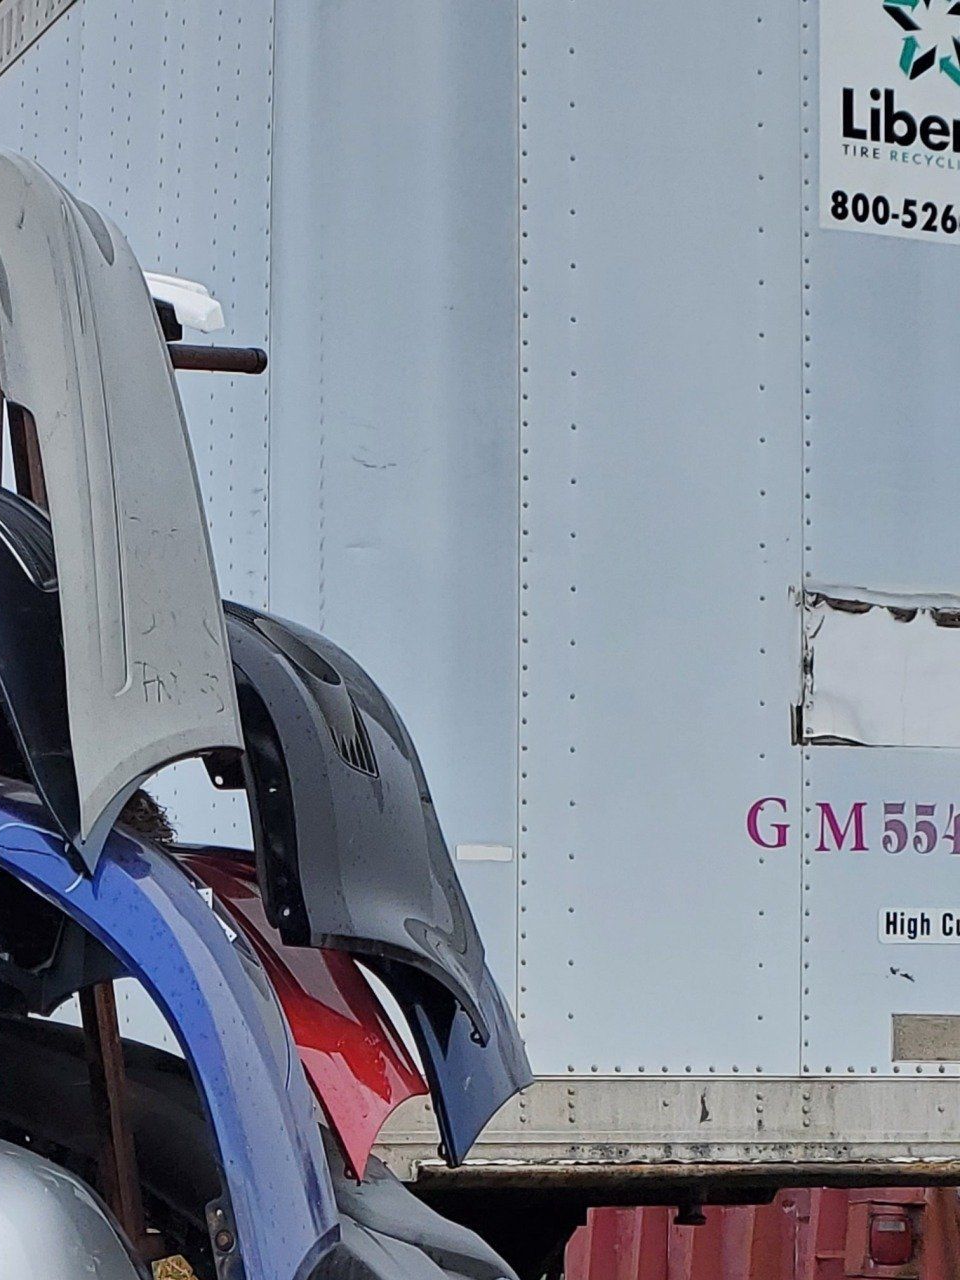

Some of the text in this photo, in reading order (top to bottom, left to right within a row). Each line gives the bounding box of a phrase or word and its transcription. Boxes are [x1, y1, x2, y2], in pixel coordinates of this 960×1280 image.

[841, 143, 881, 160] TIRE
[830, 190, 960, 235] 800-526
[885, 911, 932, 940] High
